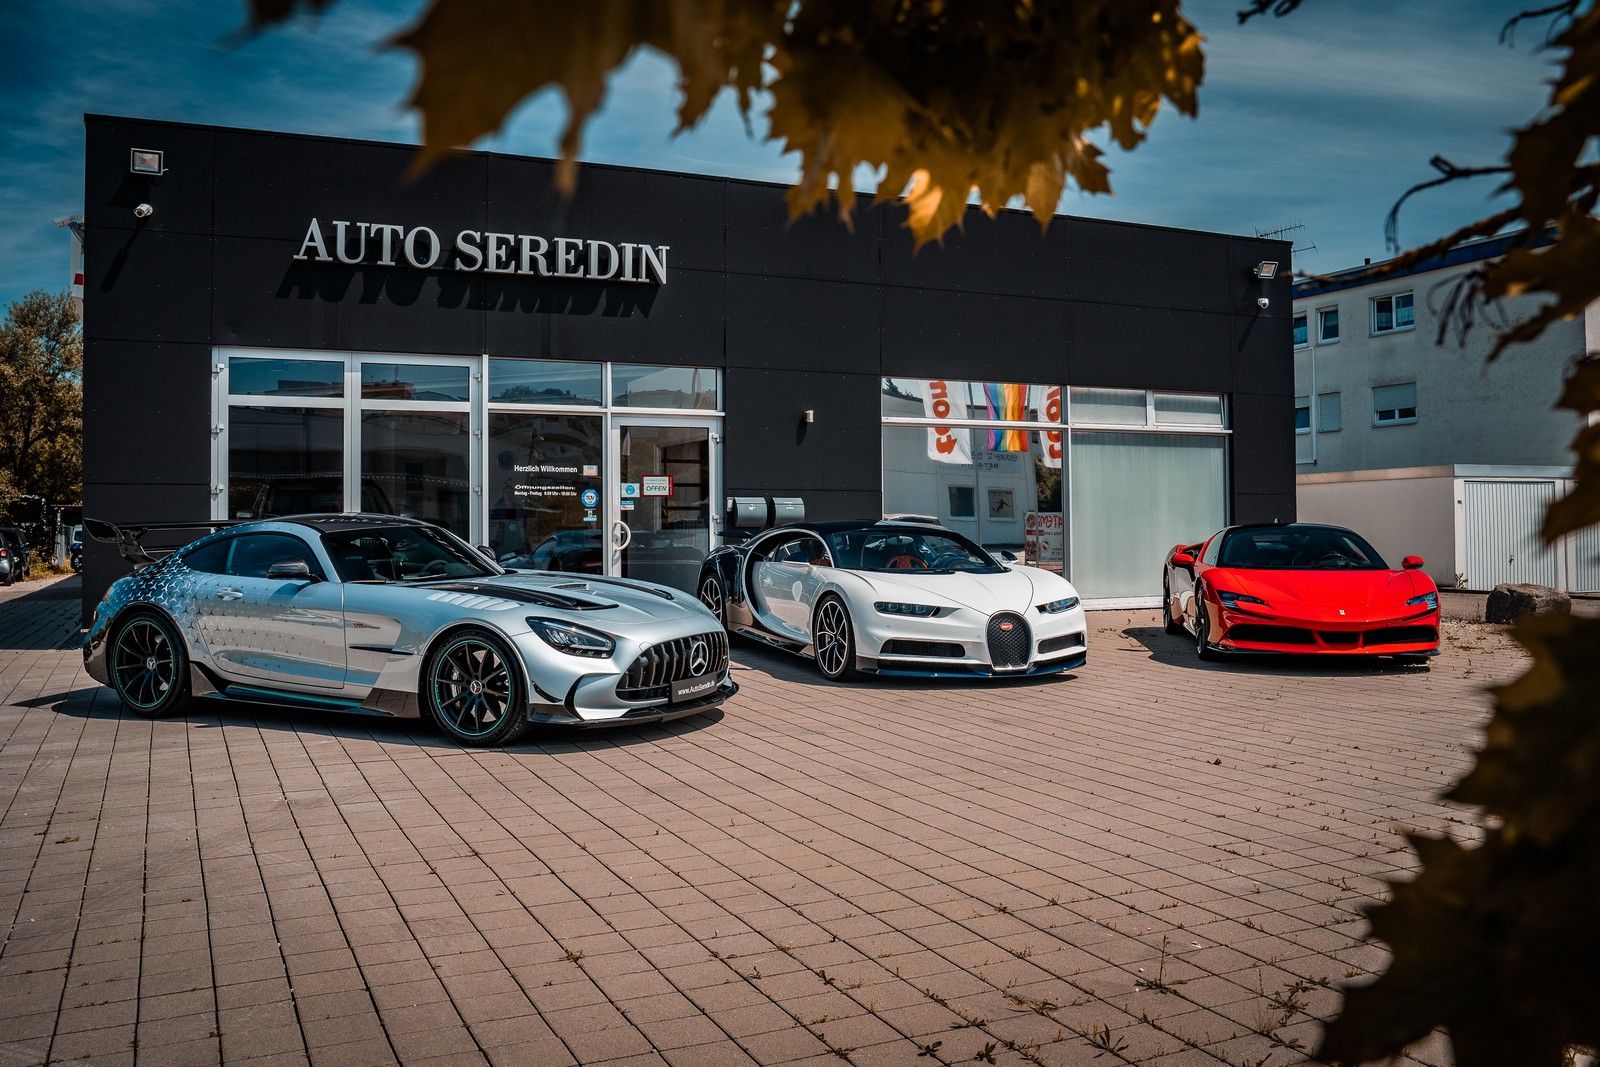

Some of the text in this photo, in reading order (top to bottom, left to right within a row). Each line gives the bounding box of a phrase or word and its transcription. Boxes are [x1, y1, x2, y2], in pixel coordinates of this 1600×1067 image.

[293, 217, 670, 285] AUTO SEREDIN
[540, 465, 578, 473] Willkommen
